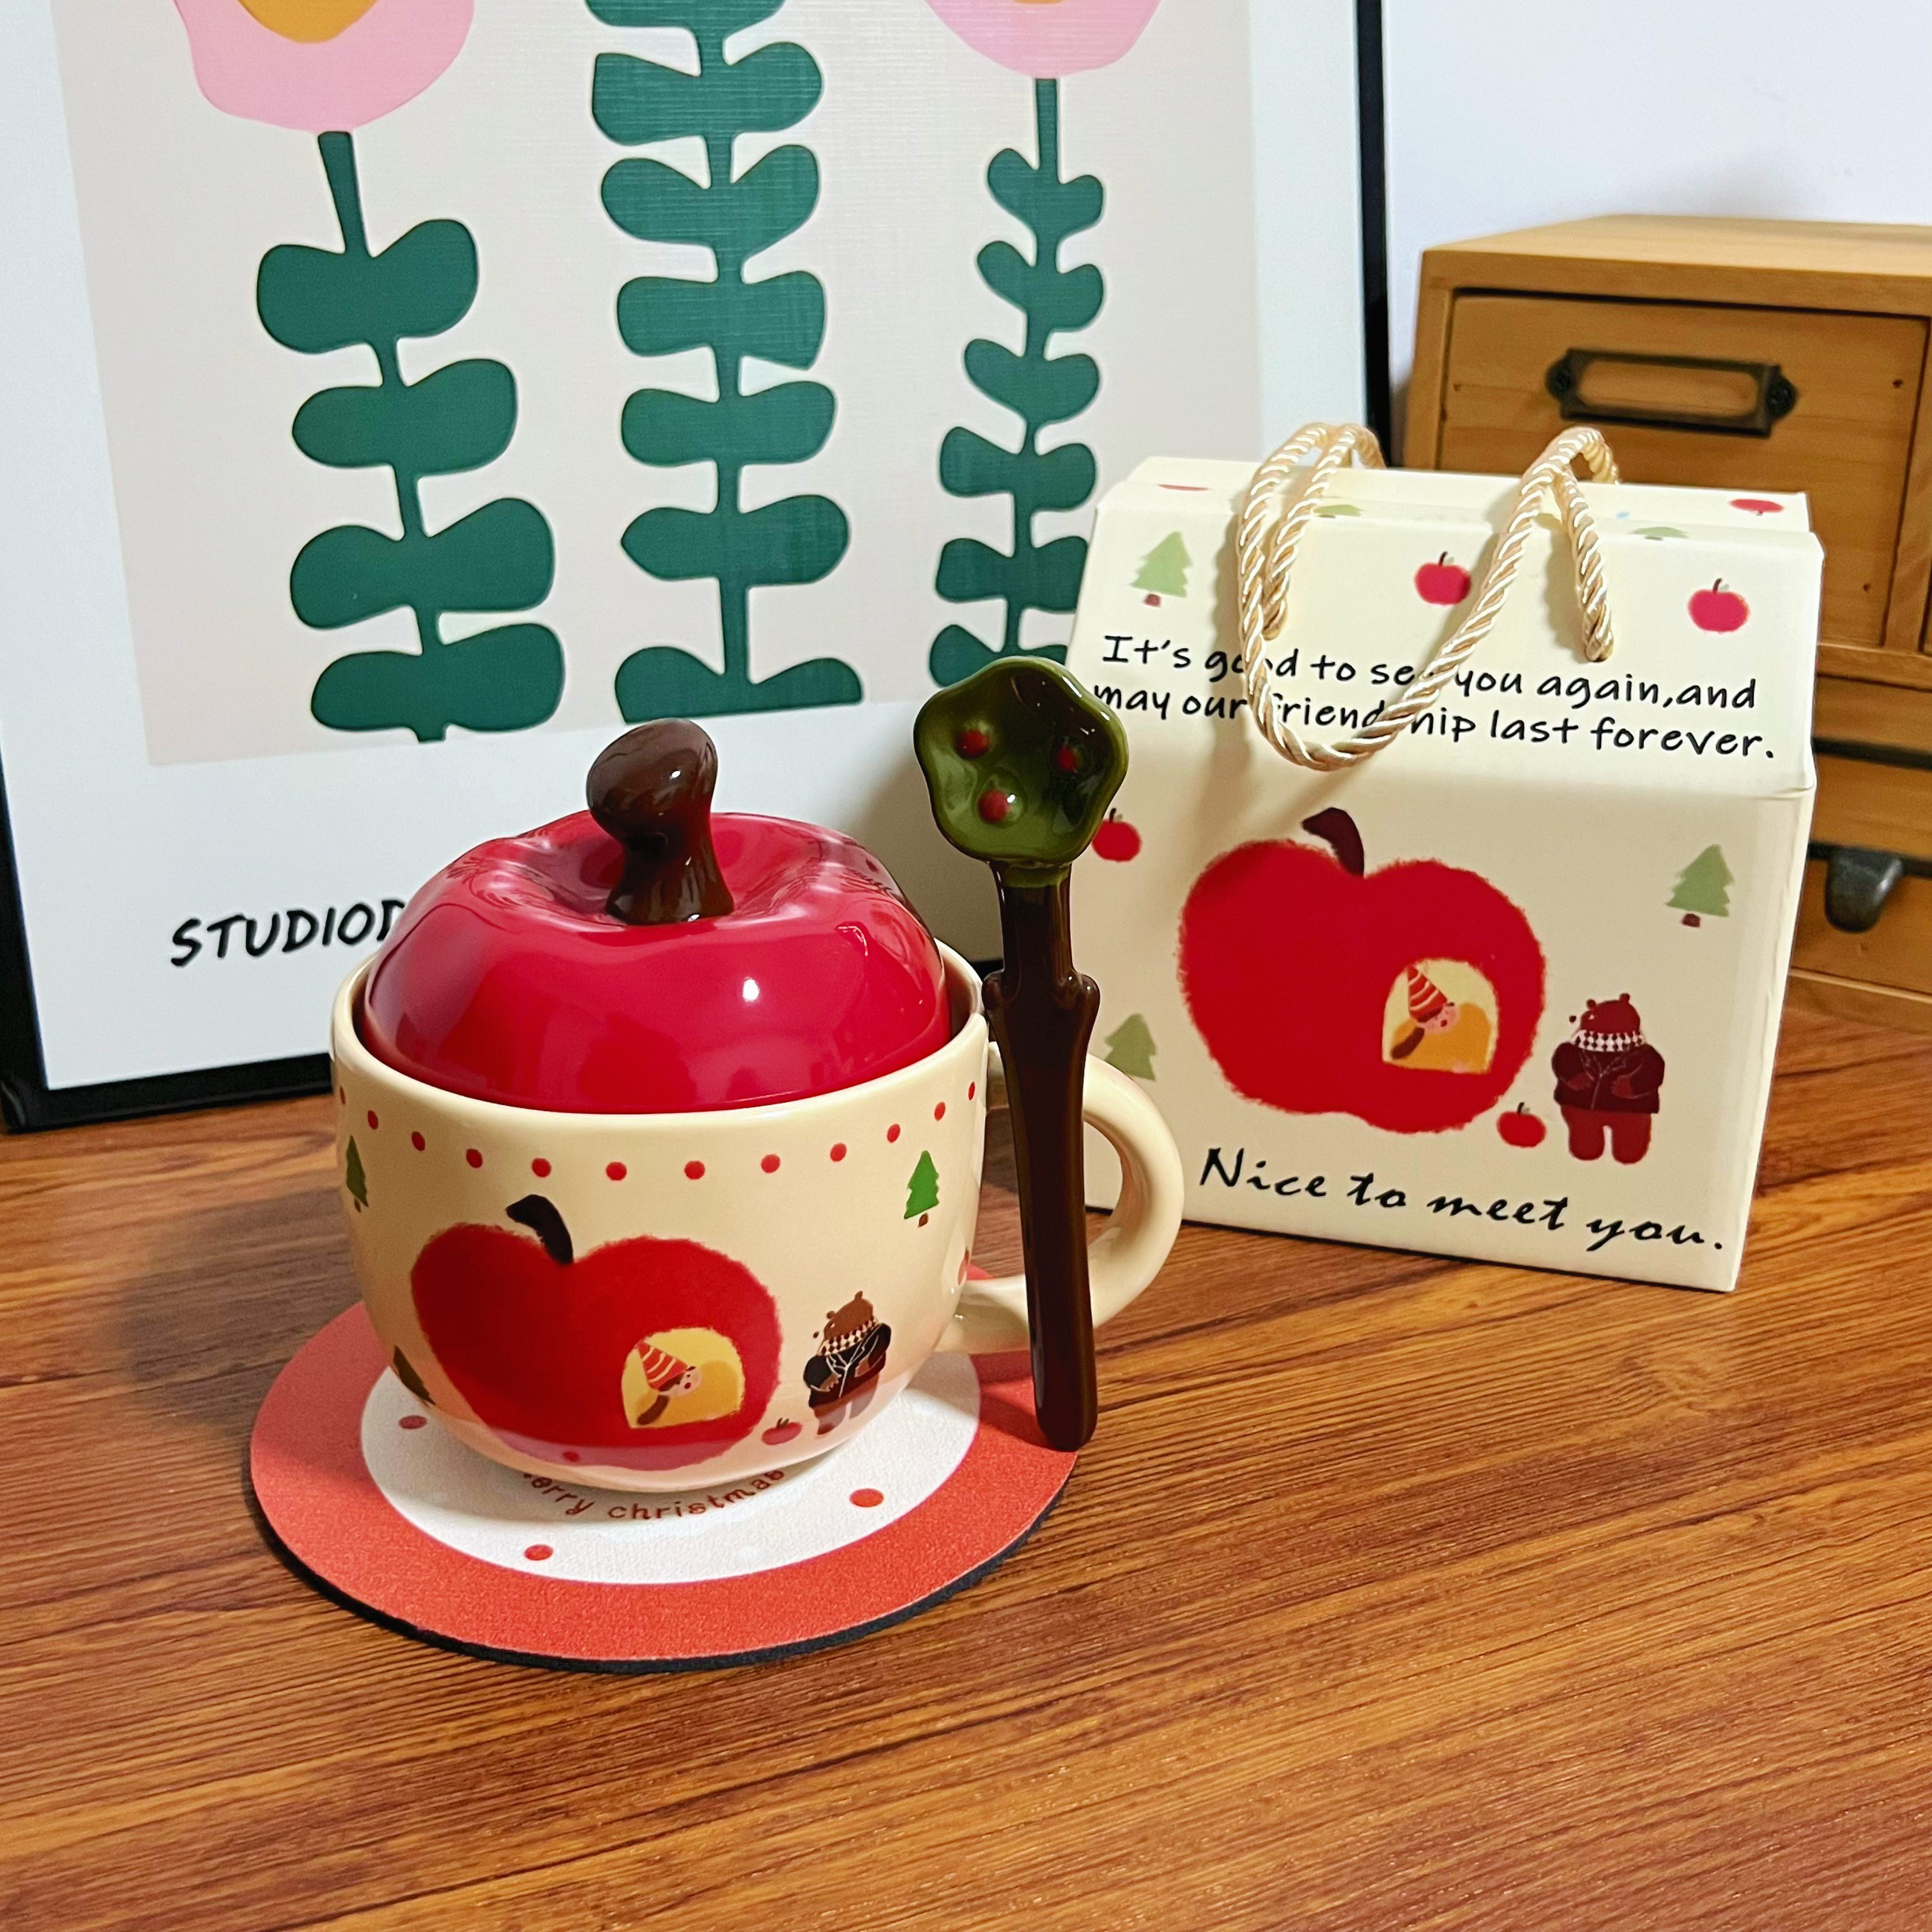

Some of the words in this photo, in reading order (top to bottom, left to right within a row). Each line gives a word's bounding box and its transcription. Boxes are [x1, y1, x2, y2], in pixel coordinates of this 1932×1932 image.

[1102, 634, 1192, 669] It's
[1204, 648, 1300, 683] god
[1310, 654, 1356, 682] to
[1370, 663, 1435, 686] se
[1454, 670, 1522, 697] you
[1094, 684, 1170, 720] may
[1182, 695, 1248, 719] our
[1272, 693, 1476, 743] riendhip
[1491, 709, 1579, 744] last
[1590, 716, 1774, 759] forever.
[1199, 1147, 1327, 1198] Nice
[1346, 1172, 1407, 1208] to
[1426, 1196, 1568, 1230] meet
[1585, 1218, 1723, 1252] you.
[523, 1472, 595, 1515] erry
